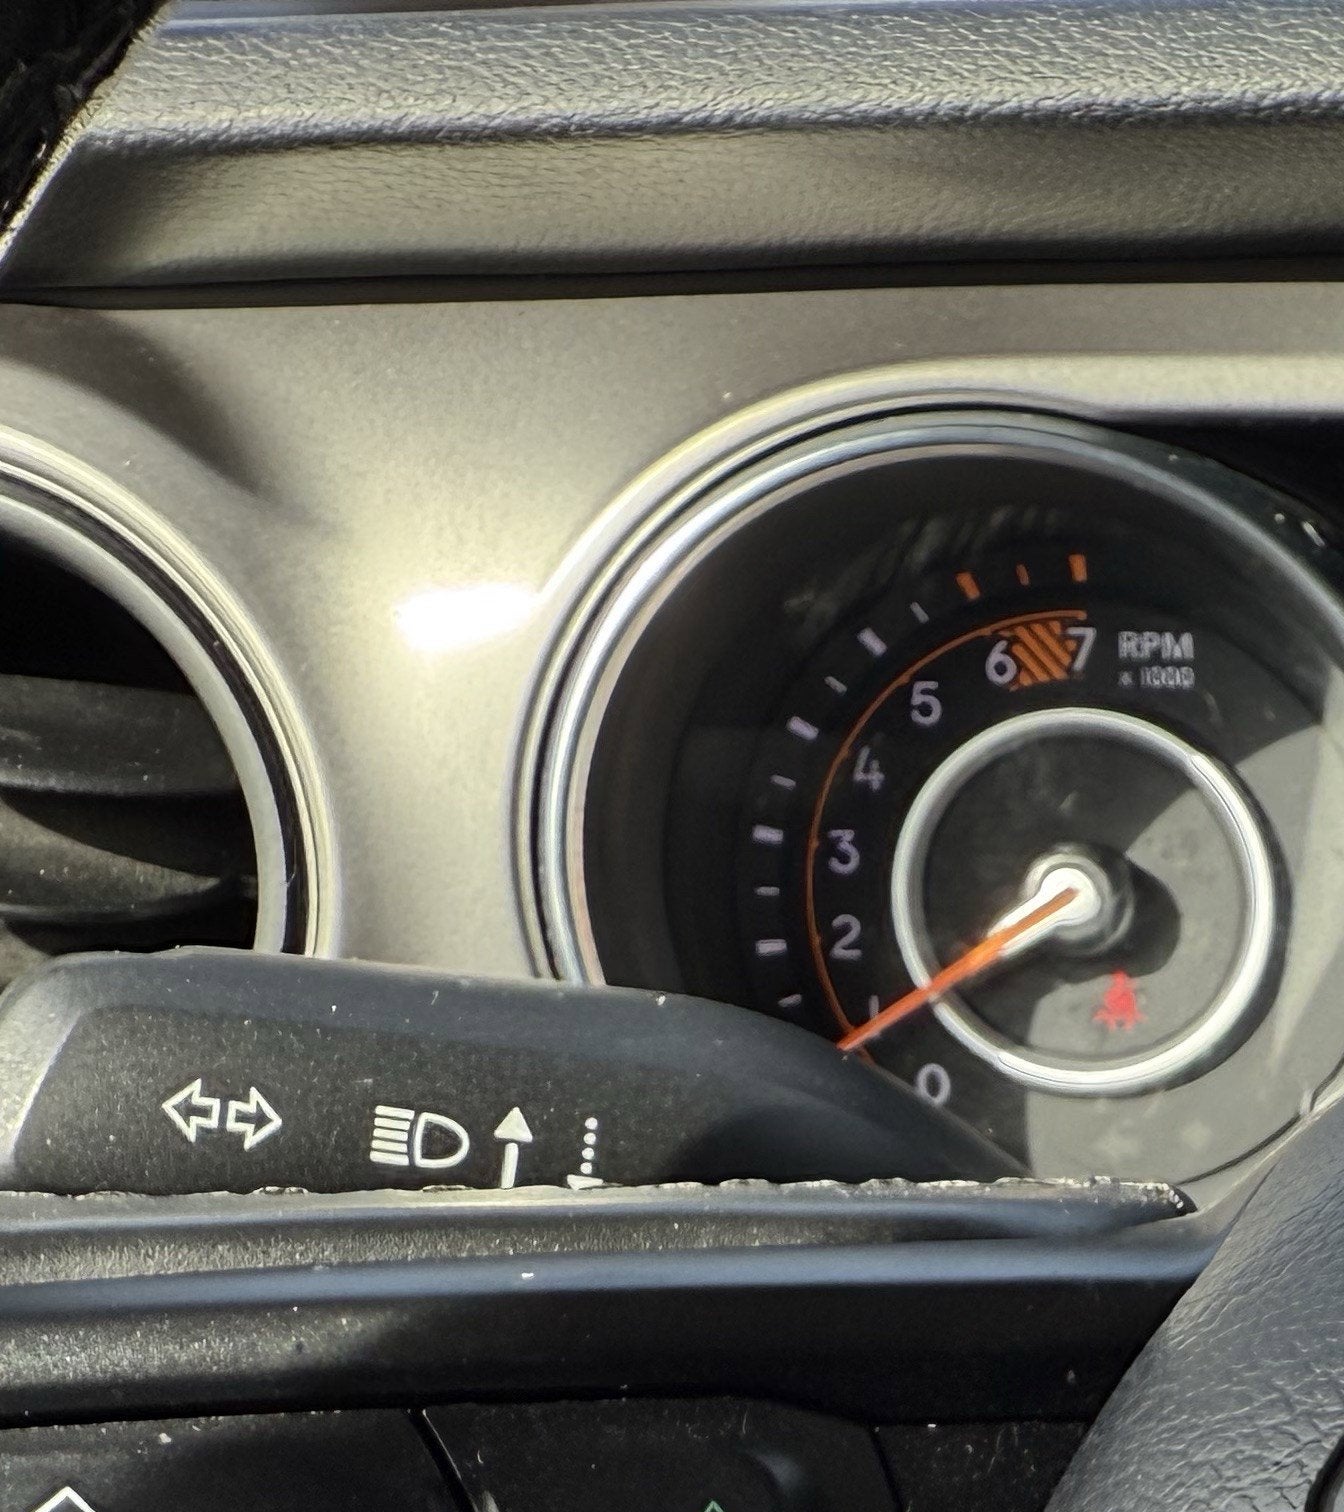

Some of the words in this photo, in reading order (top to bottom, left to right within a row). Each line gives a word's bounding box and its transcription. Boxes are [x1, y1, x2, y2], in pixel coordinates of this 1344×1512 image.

[985, 641, 1015, 684] 6
[1067, 627, 1097, 672] 7
[1118, 631, 1194, 659] RPM
[910, 681, 942, 726] 5
[853, 747, 885, 792] 4
[828, 829, 860, 875] 3
[830, 915, 862, 960] 2
[917, 1063, 950, 1106] 0
